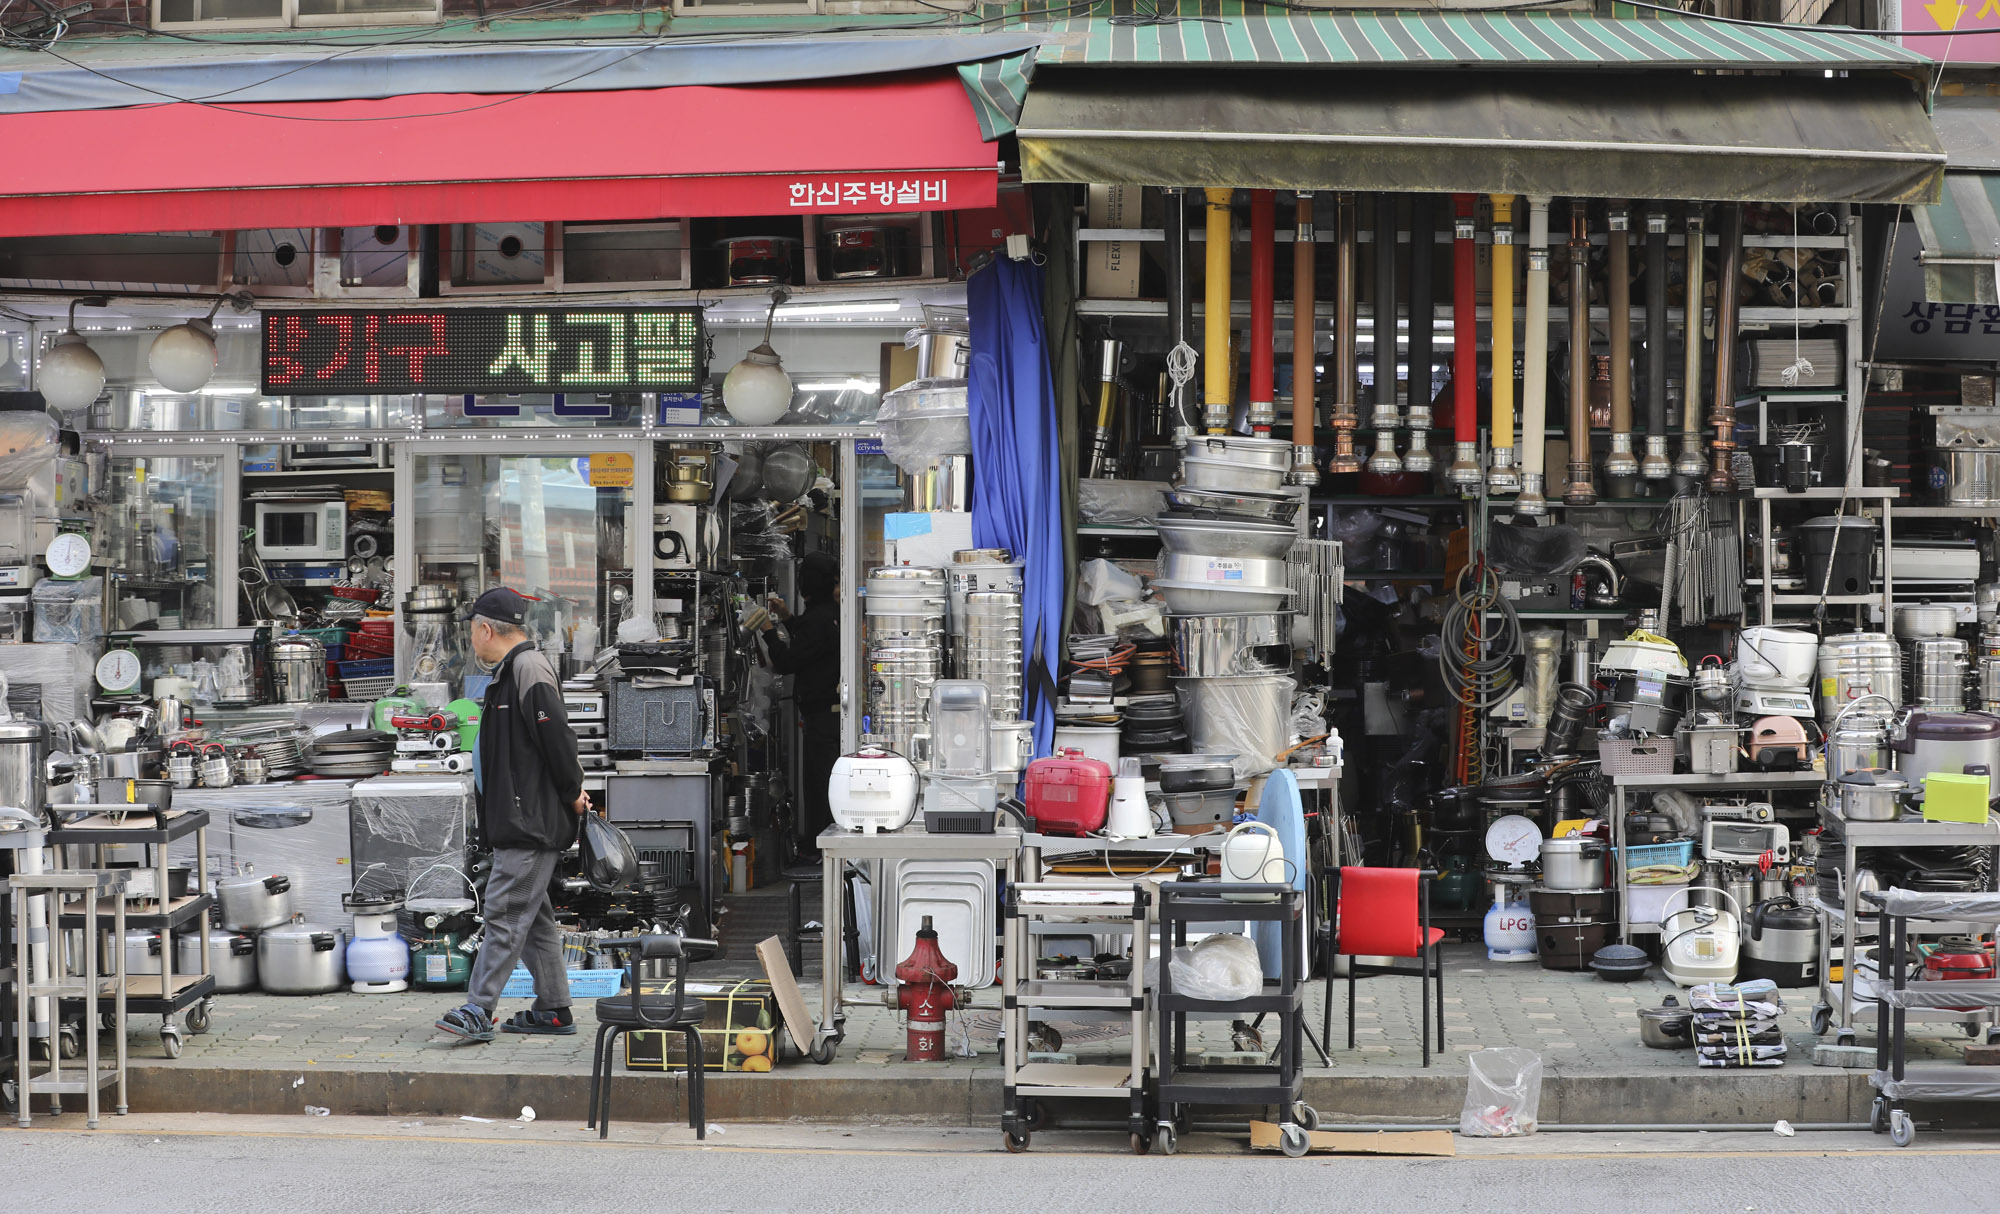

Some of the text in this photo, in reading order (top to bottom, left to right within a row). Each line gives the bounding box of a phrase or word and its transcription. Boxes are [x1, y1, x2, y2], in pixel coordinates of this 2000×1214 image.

[788, 178, 948, 208] 한신주방설비
[1111, 223, 1121, 271] FLEXIE
[488, 312, 697, 384] 사고팔
[1499, 917, 1528, 931] LPG
